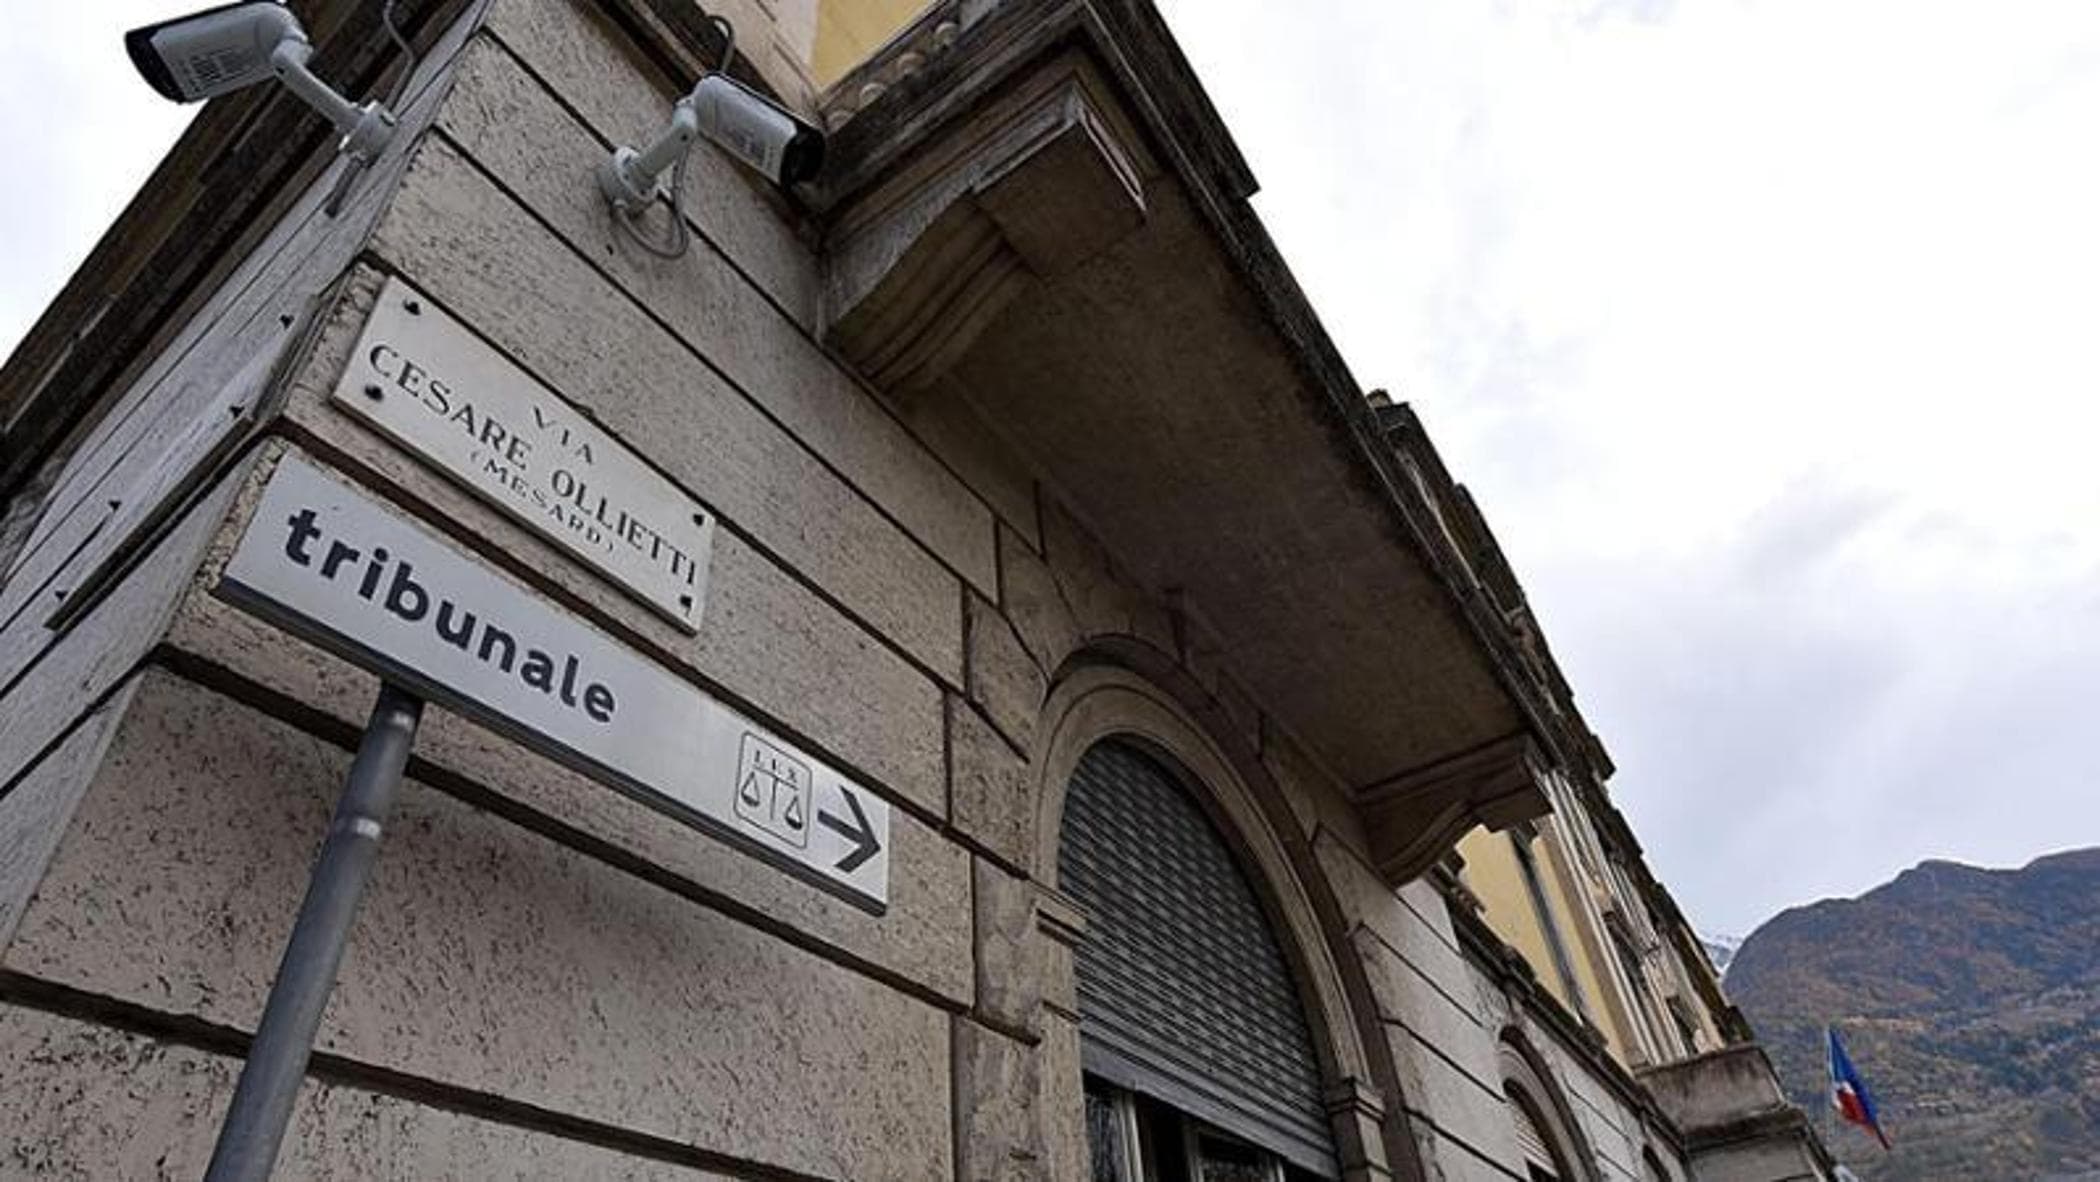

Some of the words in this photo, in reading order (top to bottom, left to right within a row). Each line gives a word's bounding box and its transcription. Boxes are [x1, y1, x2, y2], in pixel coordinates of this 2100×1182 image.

[368, 343, 532, 471] CESARE
[551, 468, 696, 586] OLLIETTI
[533, 405, 594, 466] VIA
[284, 508, 616, 724] tribunale
